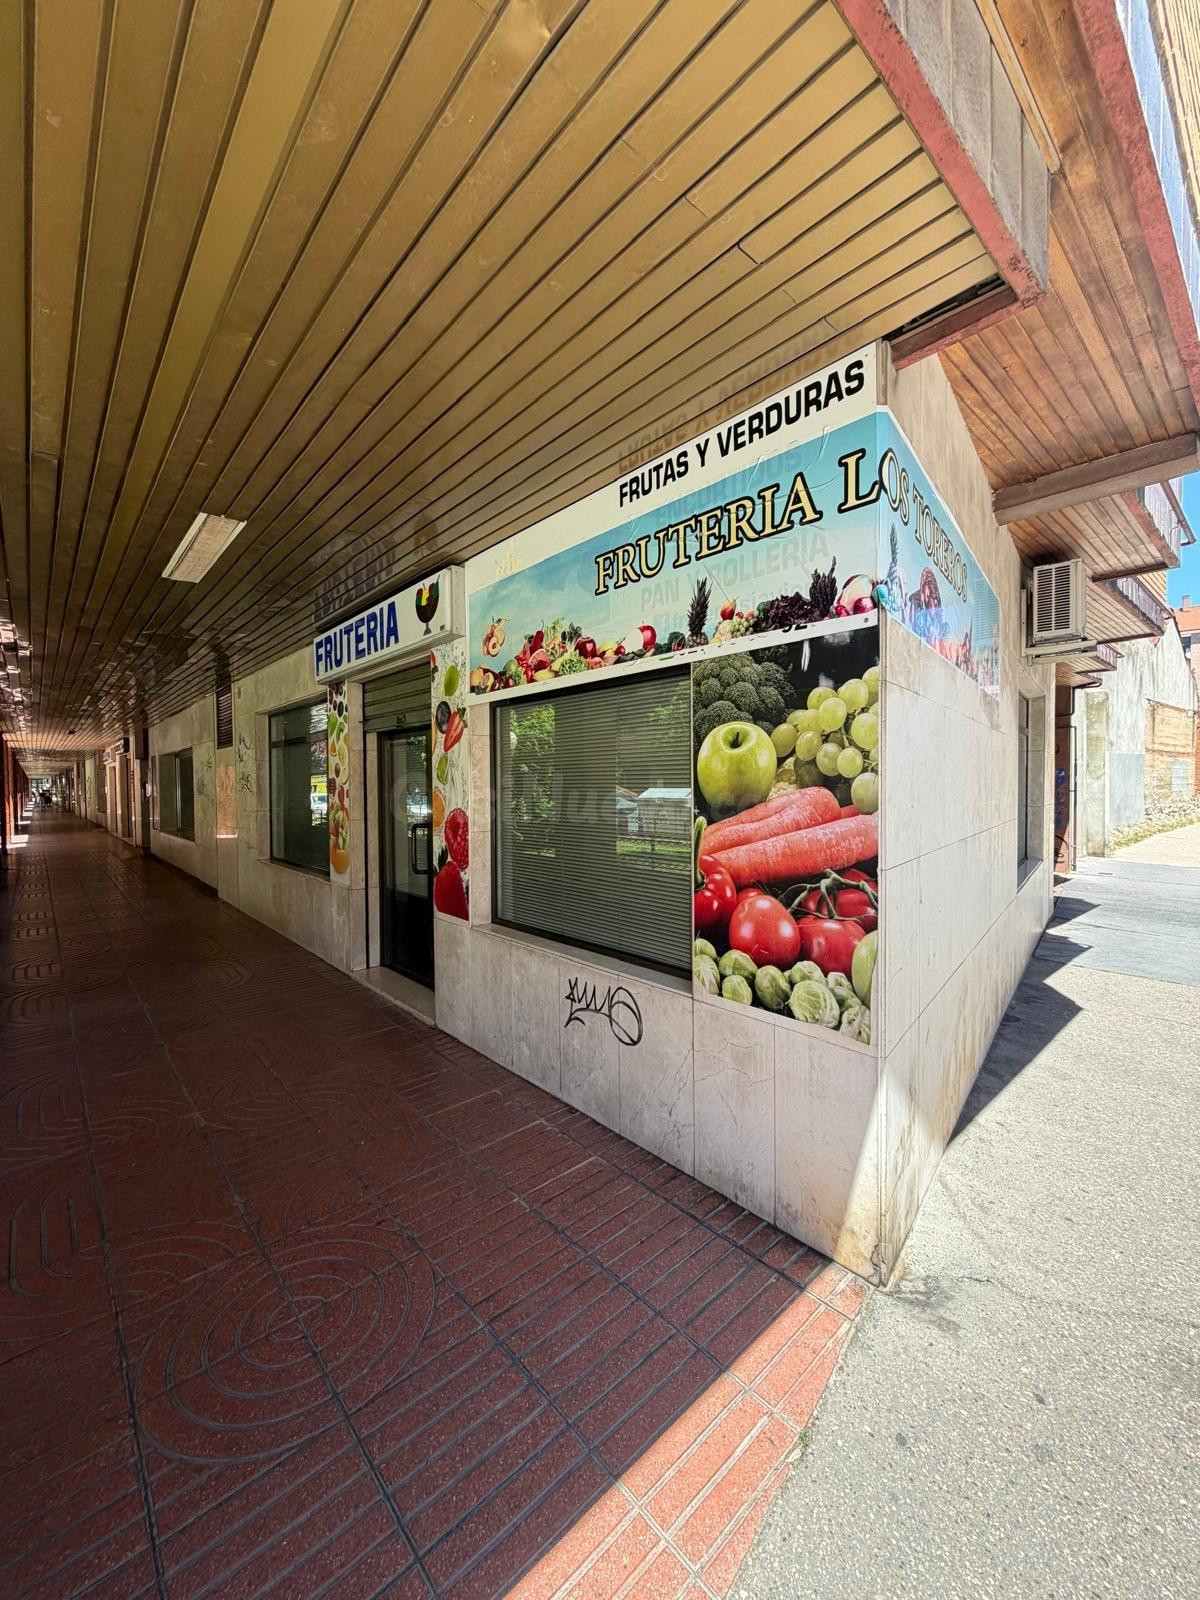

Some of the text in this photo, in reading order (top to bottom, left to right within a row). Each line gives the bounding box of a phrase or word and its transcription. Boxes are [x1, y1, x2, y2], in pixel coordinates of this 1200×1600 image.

[619, 450, 689, 508] FRUTAS
[695, 438, 710, 468] Y
[716, 359, 865, 458] VERDURAS
[594, 447, 968, 604] FRUTERIA LOS TOREROS
[314, 600, 400, 677] FRUTERIA
